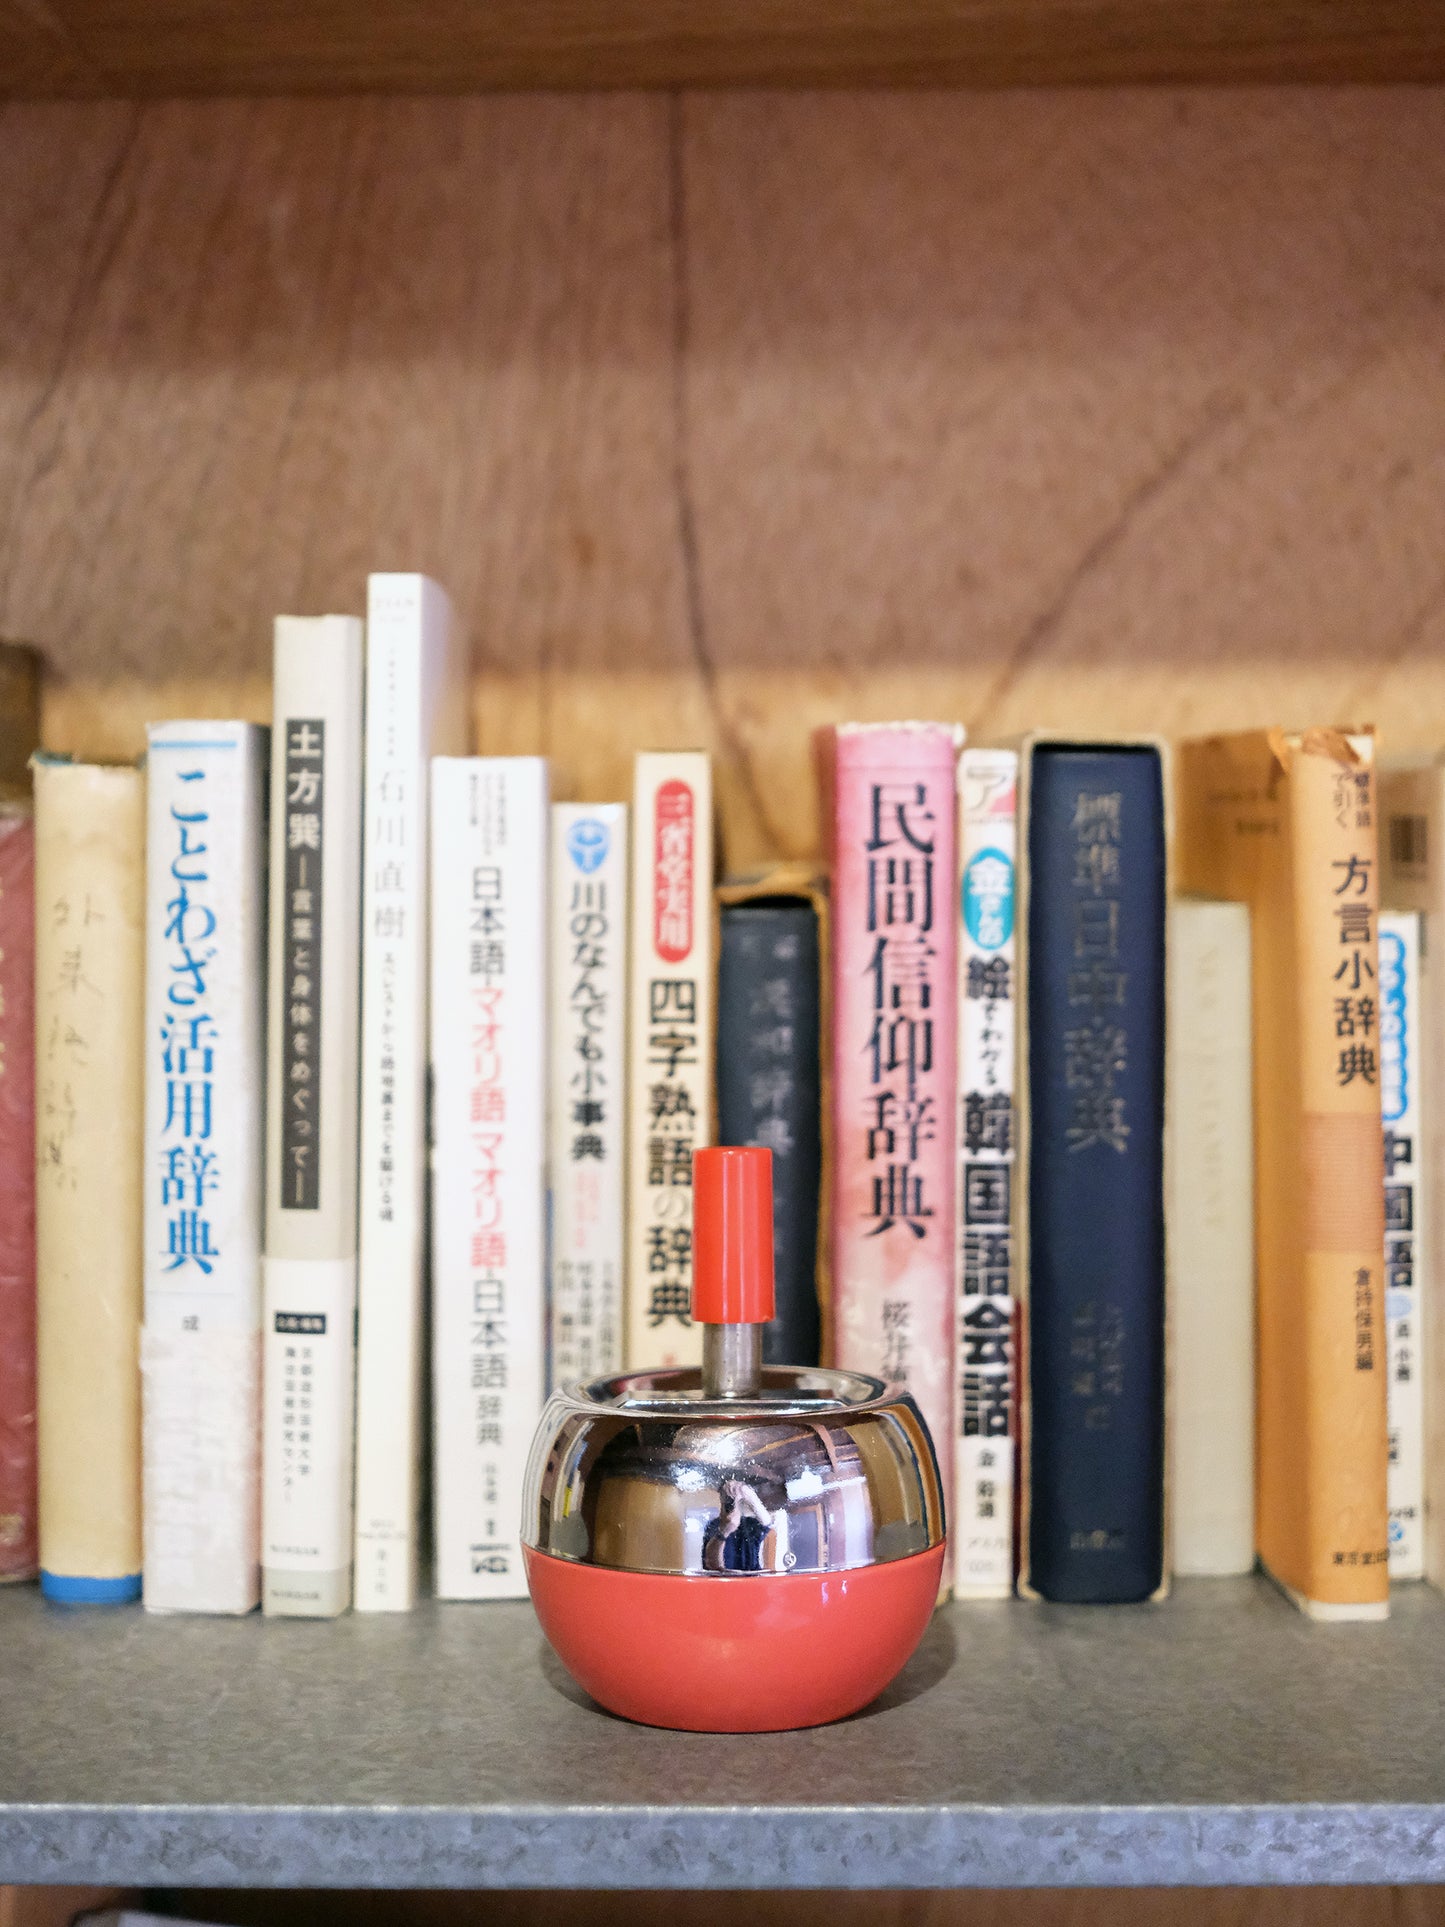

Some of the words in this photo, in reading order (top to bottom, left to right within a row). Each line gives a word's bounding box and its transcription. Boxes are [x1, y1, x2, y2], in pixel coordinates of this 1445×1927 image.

[160, 770, 219, 1275] ことわざ活用辞典
[570, 881, 607, 1163] 川のなんでも小事典
[863, 782, 937, 1239] 民間信仰辞典
[1331, 854, 1377, 1087] 方言小辞典
[647, 978, 698, 1328] 四字熟語の辞典
